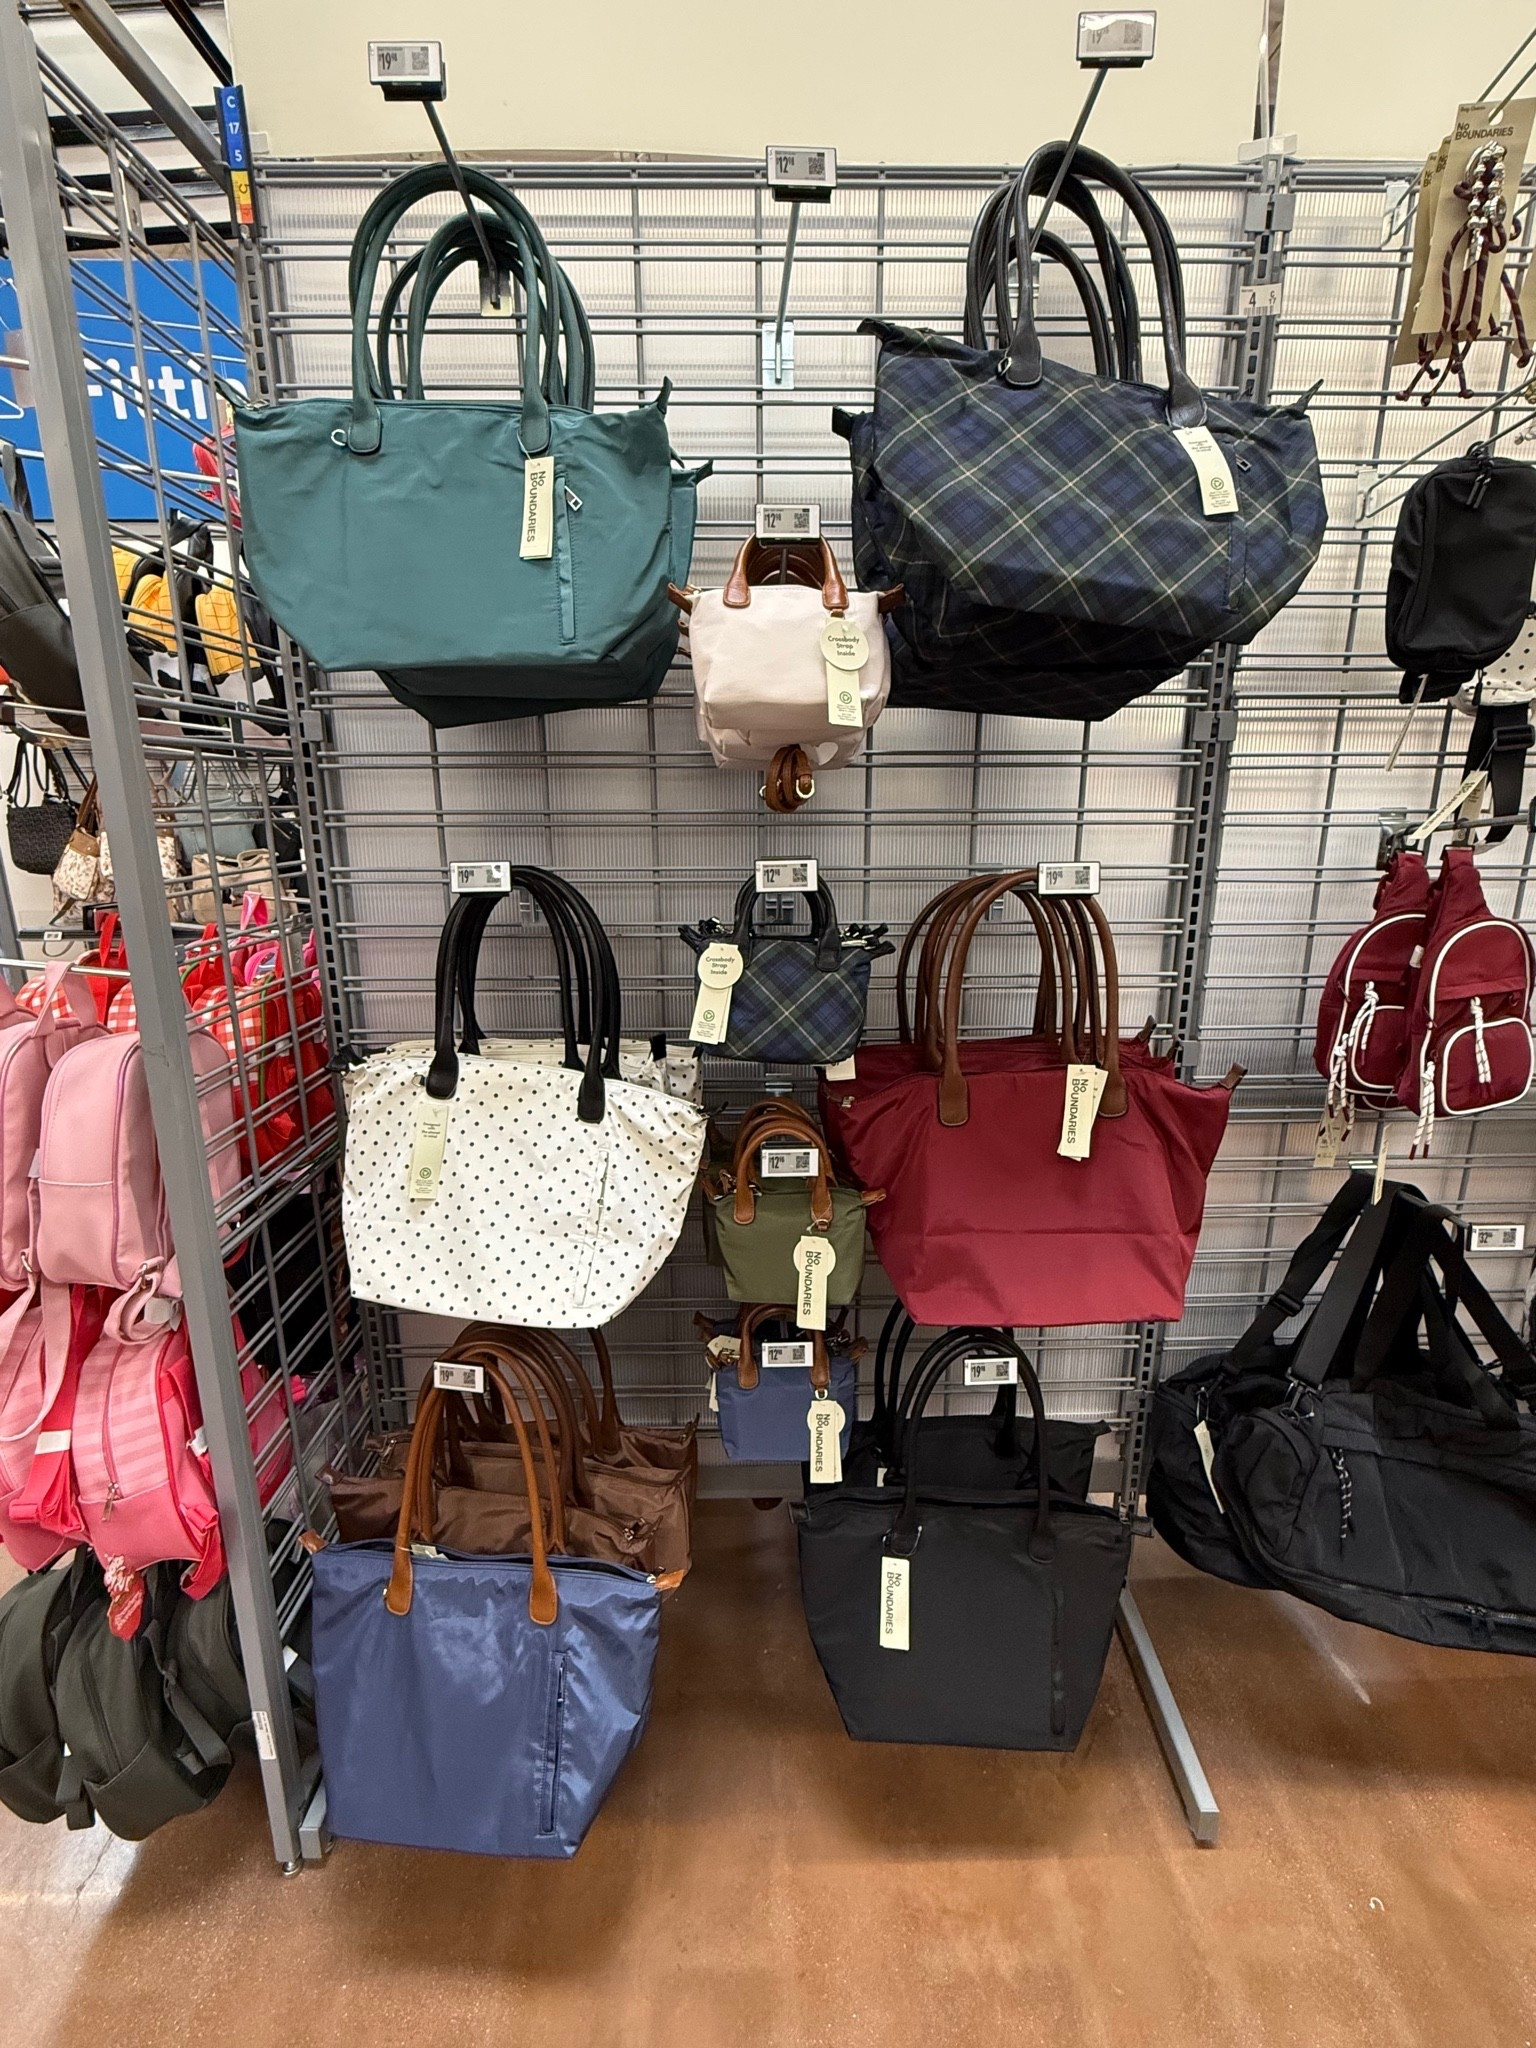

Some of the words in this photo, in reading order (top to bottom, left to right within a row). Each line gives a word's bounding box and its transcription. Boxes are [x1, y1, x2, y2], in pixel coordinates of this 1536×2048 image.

[226, 95, 236, 108] C
[228, 122, 239, 135] 17
[1455, 127, 1514, 141] BOUNDARIES
[234, 149, 243, 162] 5
[1248, 291, 1257, 308] 4
[526, 472, 539, 543] BOUNDARIES
[827, 635, 860, 644] Crossbody
[836, 642, 854, 650] Strap
[705, 956, 735, 964] Crossbody
[1067, 1078, 1081, 1144] BOUNDARIES
[802, 1250, 814, 1316] BOUNDARIES
[815, 1413, 824, 1473] BOUNDARIES
[885, 1571, 895, 1635] BOUNDARIES
